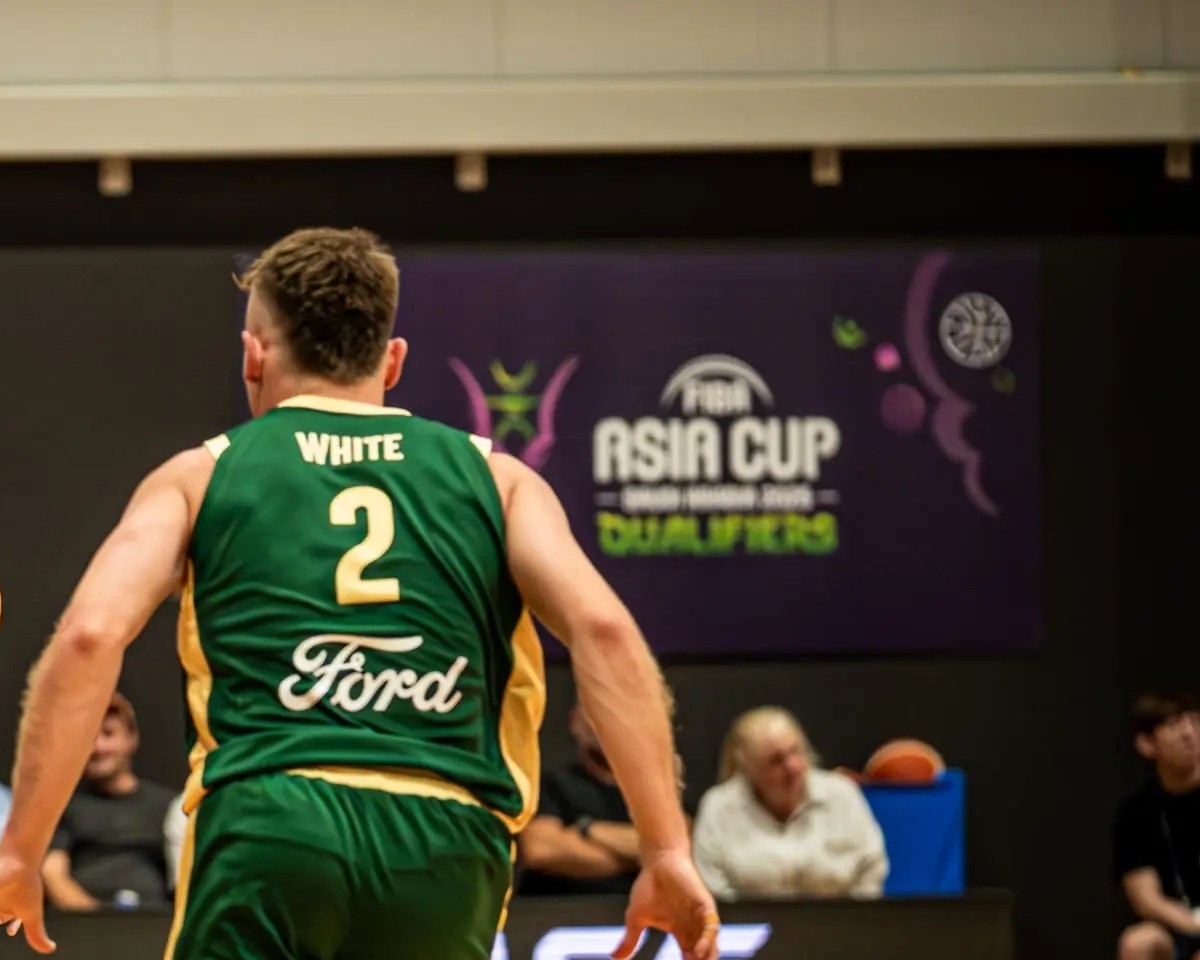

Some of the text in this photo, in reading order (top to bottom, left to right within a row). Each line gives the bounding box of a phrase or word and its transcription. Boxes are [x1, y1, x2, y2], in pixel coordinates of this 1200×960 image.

[294, 431, 405, 466] WHITE
[593, 415, 841, 484] ASIA CUP
[328, 485, 401, 606] 2
[277, 633, 469, 714] Ford
